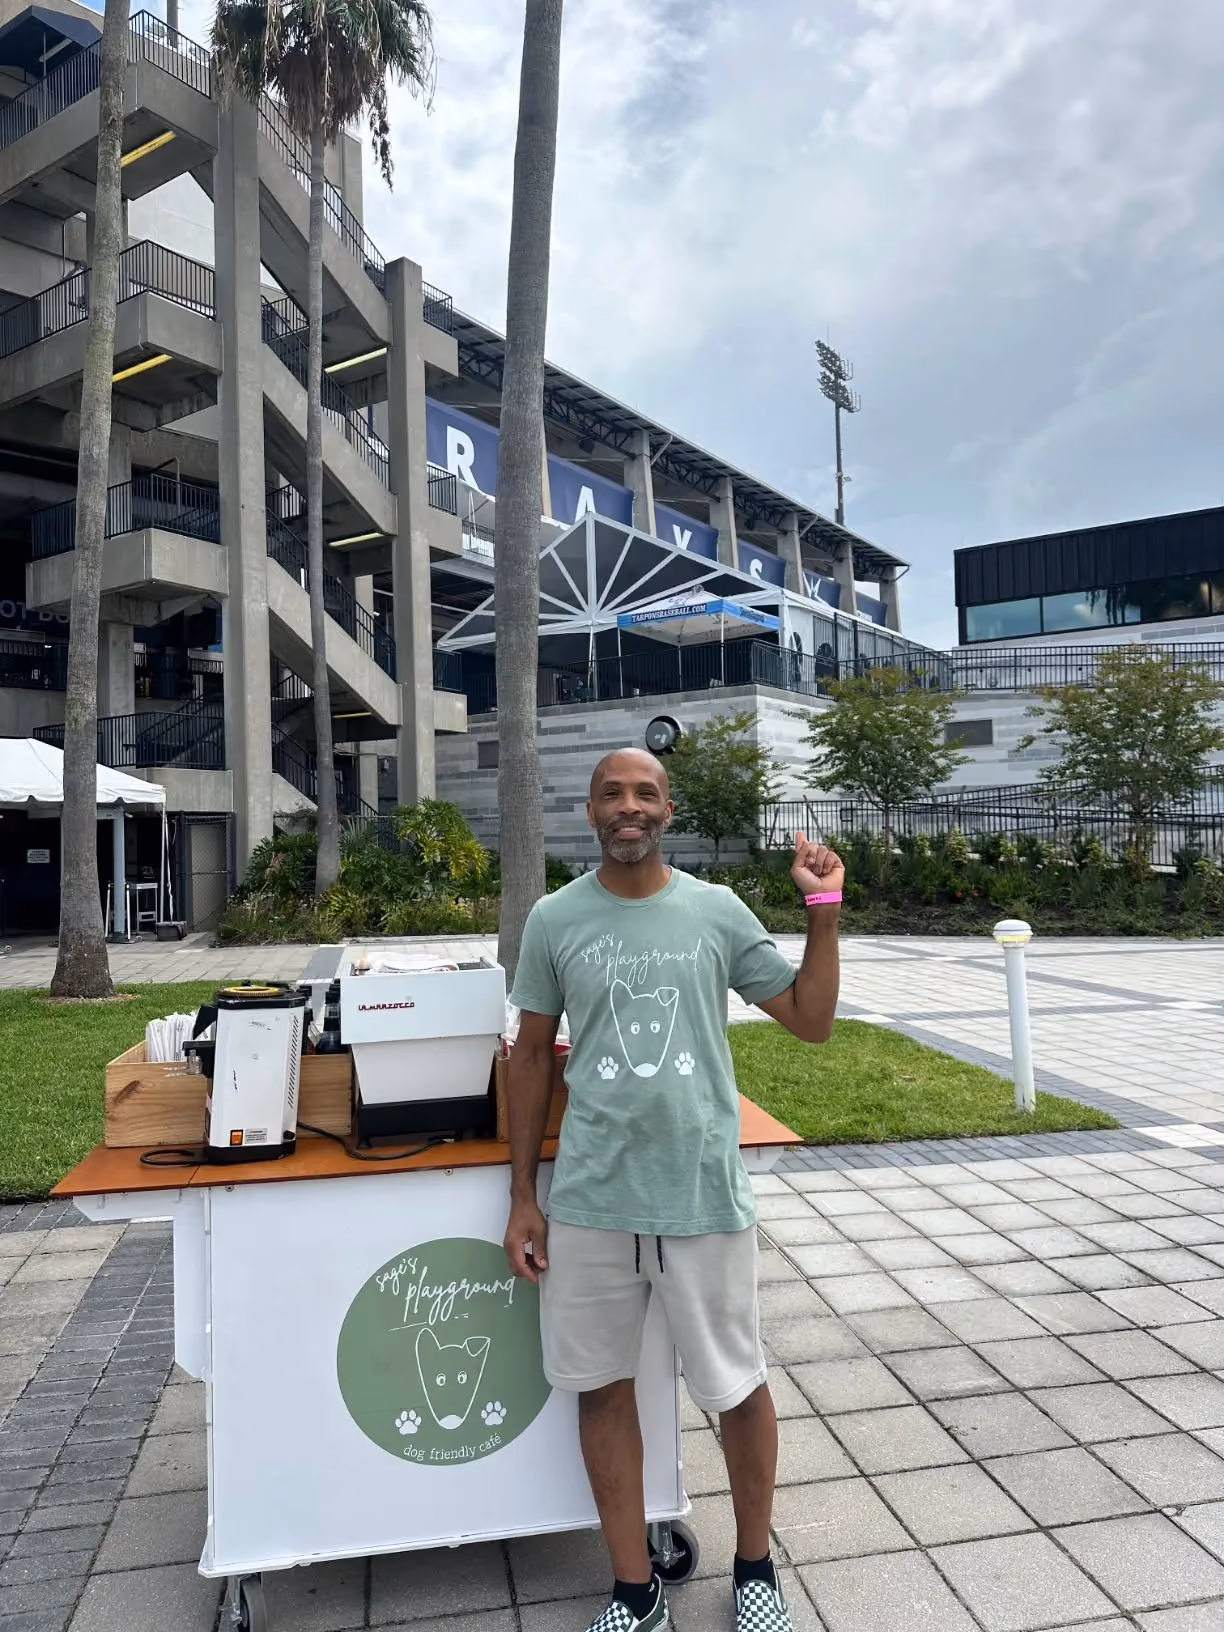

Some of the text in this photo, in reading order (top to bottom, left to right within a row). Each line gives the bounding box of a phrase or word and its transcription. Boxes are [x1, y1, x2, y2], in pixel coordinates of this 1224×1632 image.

[631, 604, 707, 623] TARPONSBASEBALL.COM
[581, 933, 615, 965] sage's
[606, 938, 701, 988] playground
[376, 1257, 418, 1295] sage's
[404, 1266, 516, 1325] playground
[403, 1432, 502, 1461] dog friendly café
